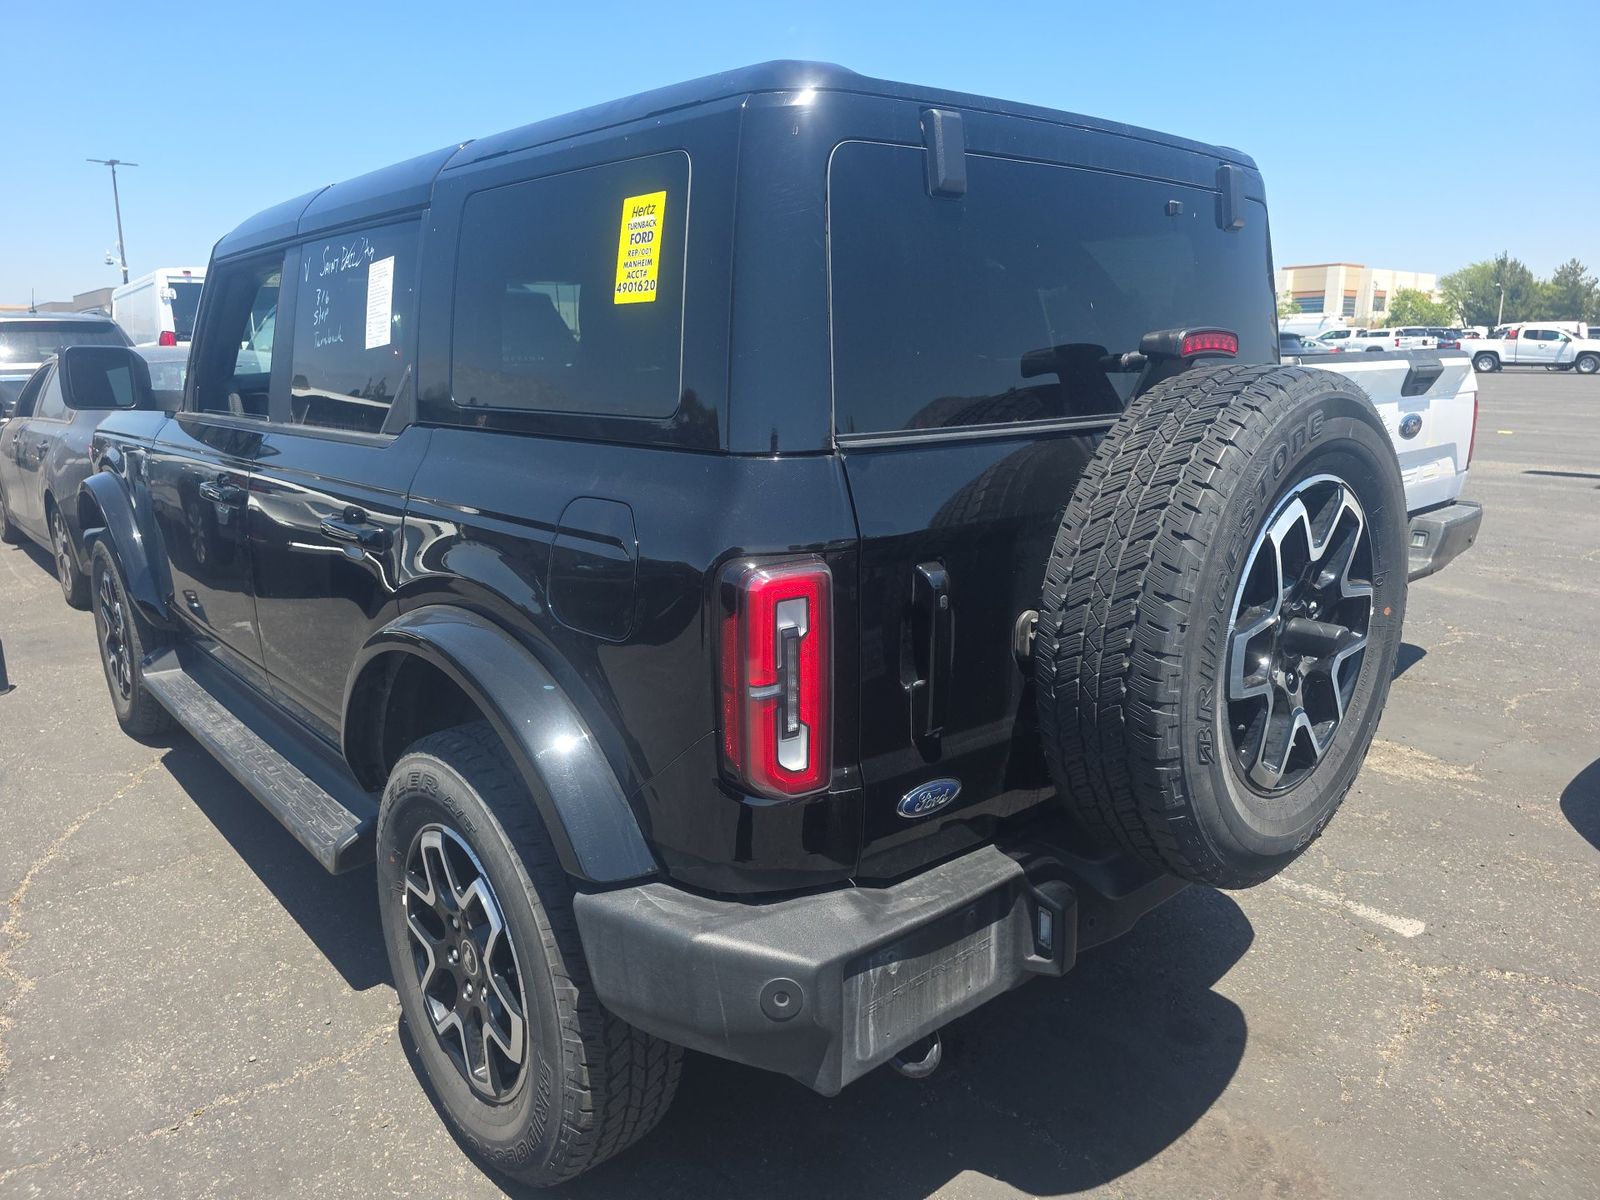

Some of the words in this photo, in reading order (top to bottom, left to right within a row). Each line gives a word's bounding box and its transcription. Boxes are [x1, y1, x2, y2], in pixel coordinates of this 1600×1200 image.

[631, 203, 656, 218] Hertz
[627, 219, 657, 231] TURNBACK
[629, 230, 654, 245] FORD
[623, 258, 653, 269] MANHEIM
[626, 269, 647, 279] ACCT#
[616, 279, 656, 293] 4901620
[914, 787, 950, 812] Ford
